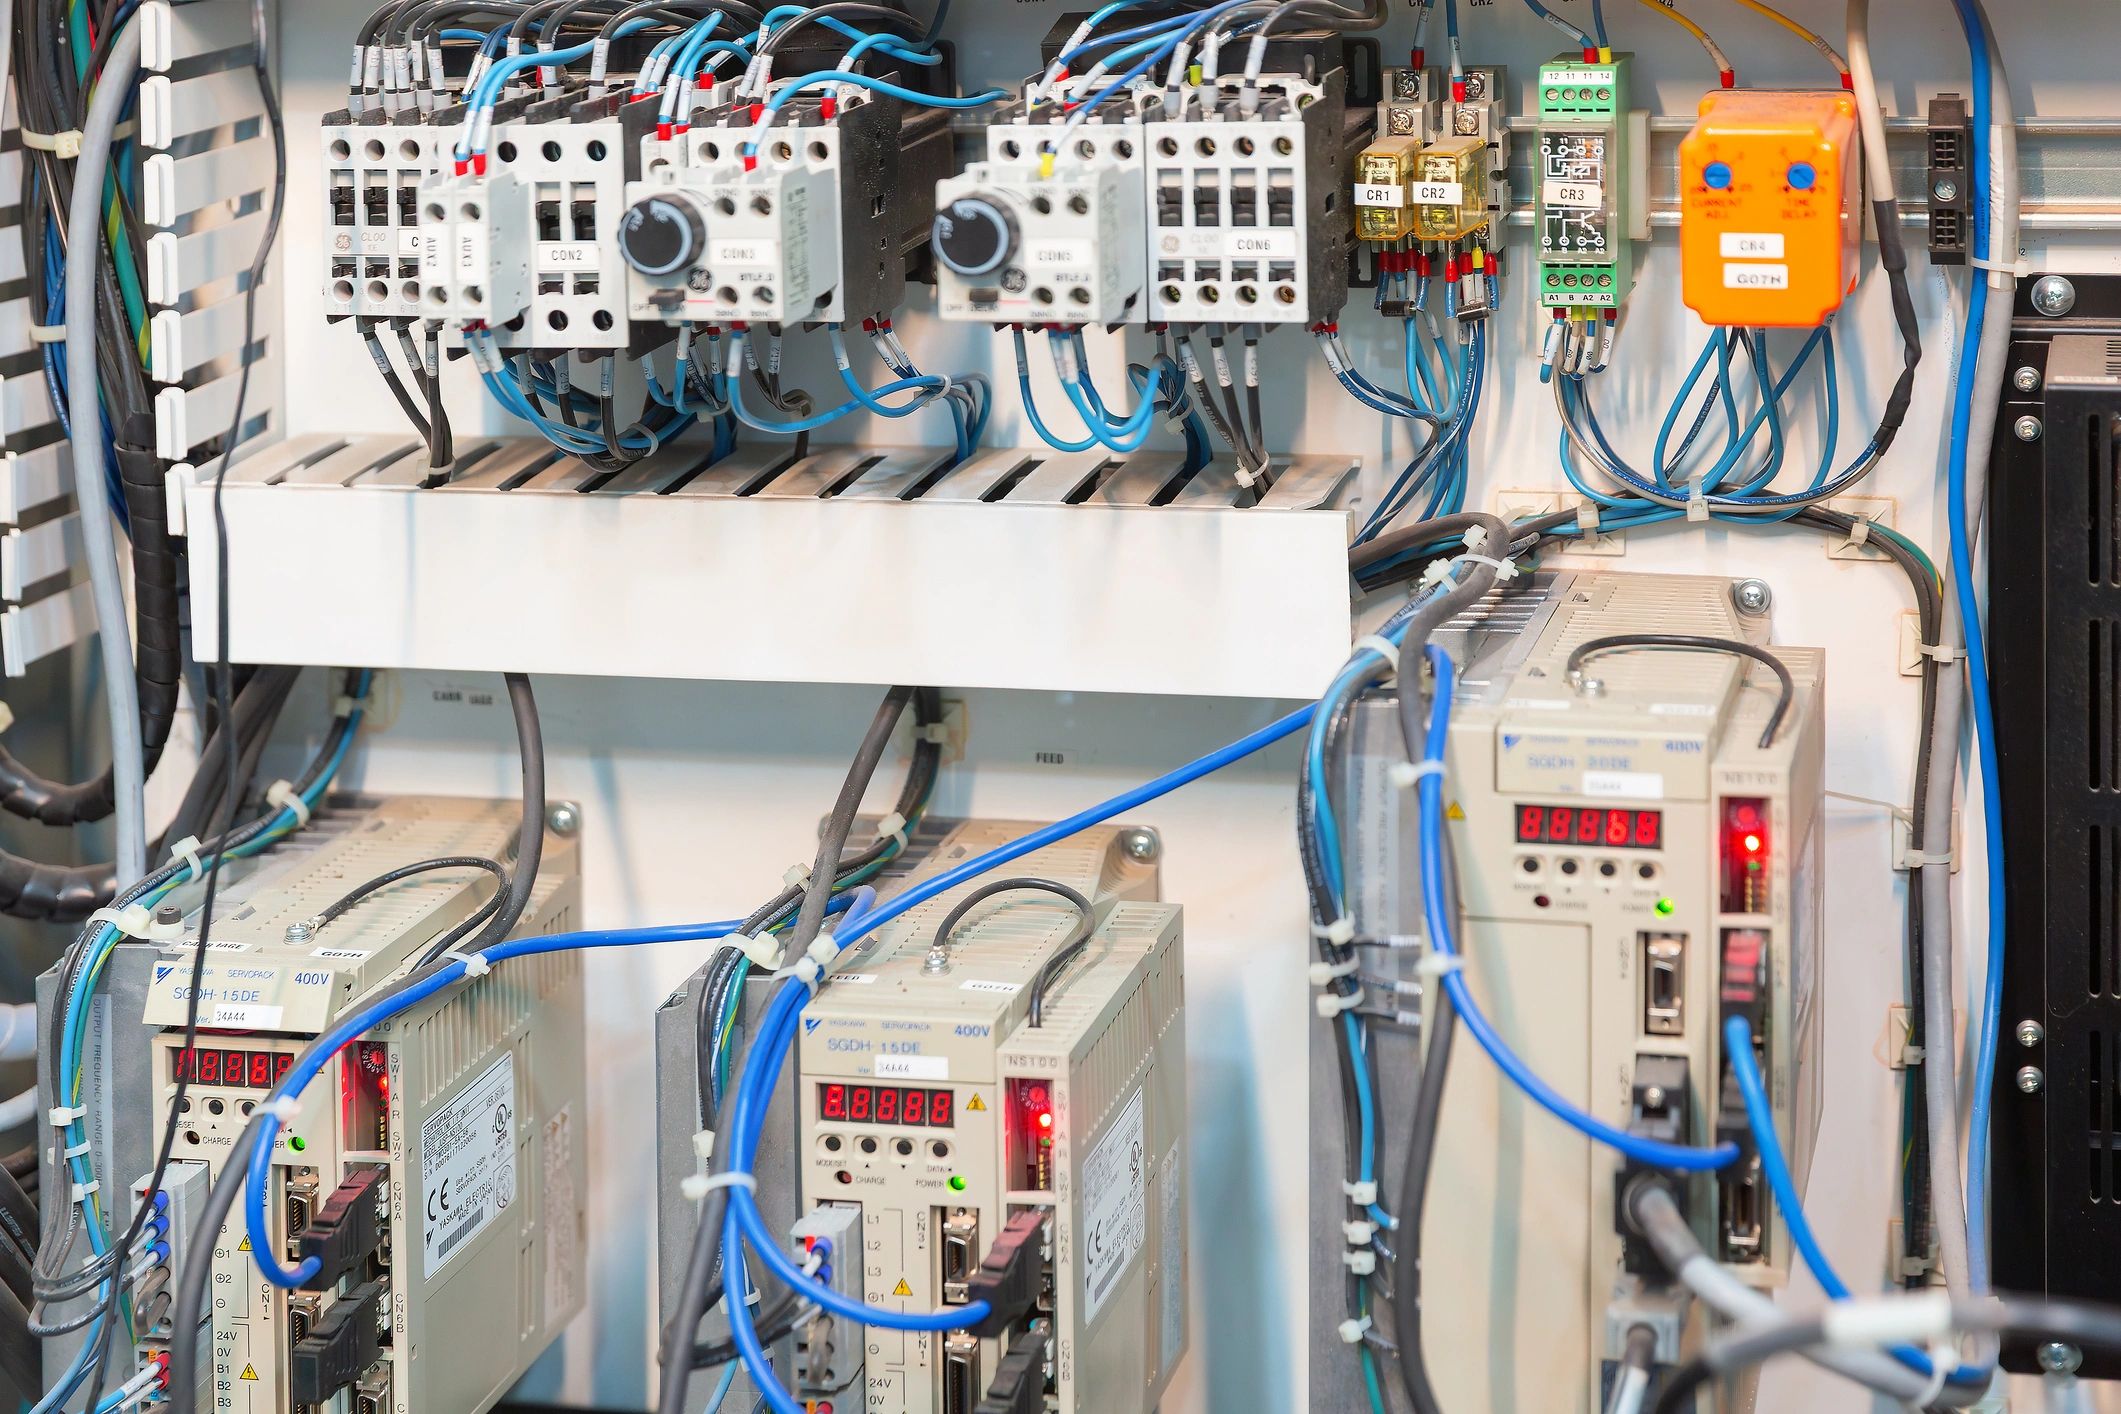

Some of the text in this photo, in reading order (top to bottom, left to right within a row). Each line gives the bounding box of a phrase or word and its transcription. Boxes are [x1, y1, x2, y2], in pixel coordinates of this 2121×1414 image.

[1366, 189, 1390, 201] CR1
[1421, 187, 1446, 199] CR2
[1560, 188, 1585, 200] CR3
[1237, 238, 1271, 251] CON6
[1739, 240, 1766, 252] CR4
[551, 249, 583, 261] CON2
[1737, 273, 1782, 285] G07H
[1036, 752, 1064, 765] FEED
[227, 969, 274, 979] SERVOPACK
[294, 972, 330, 985] 400V
[880, 1021, 931, 1031] SERVOPACK
[953, 1024, 990, 1037] 400V
[1009, 1056, 1058, 1068] NS100
[92, 999, 103, 1145] OUTPUT FREQUENCY RANGE
[202, 1136, 231, 1146] CHARGE
[855, 1175, 886, 1185] CHARGE
[915, 1179, 944, 1188] POWER
[393, 1182, 402, 1221] CN6A
[867, 1214, 880, 1224] L1
[917, 1212, 926, 1243] CN3
[867, 1240, 881, 1250] L2
[868, 1267, 882, 1277] L3
[262, 1283, 270, 1313] CN1
[395, 1294, 405, 1333] CN6B
[216, 1332, 238, 1340] 24V
[216, 1348, 231, 1357] 0V
[217, 1365, 231, 1373] B1
[217, 1381, 232, 1390] B2
[869, 1378, 892, 1388] 24V
[217, 1398, 232, 1407] B3
[869, 1395, 885, 1405] 0V
